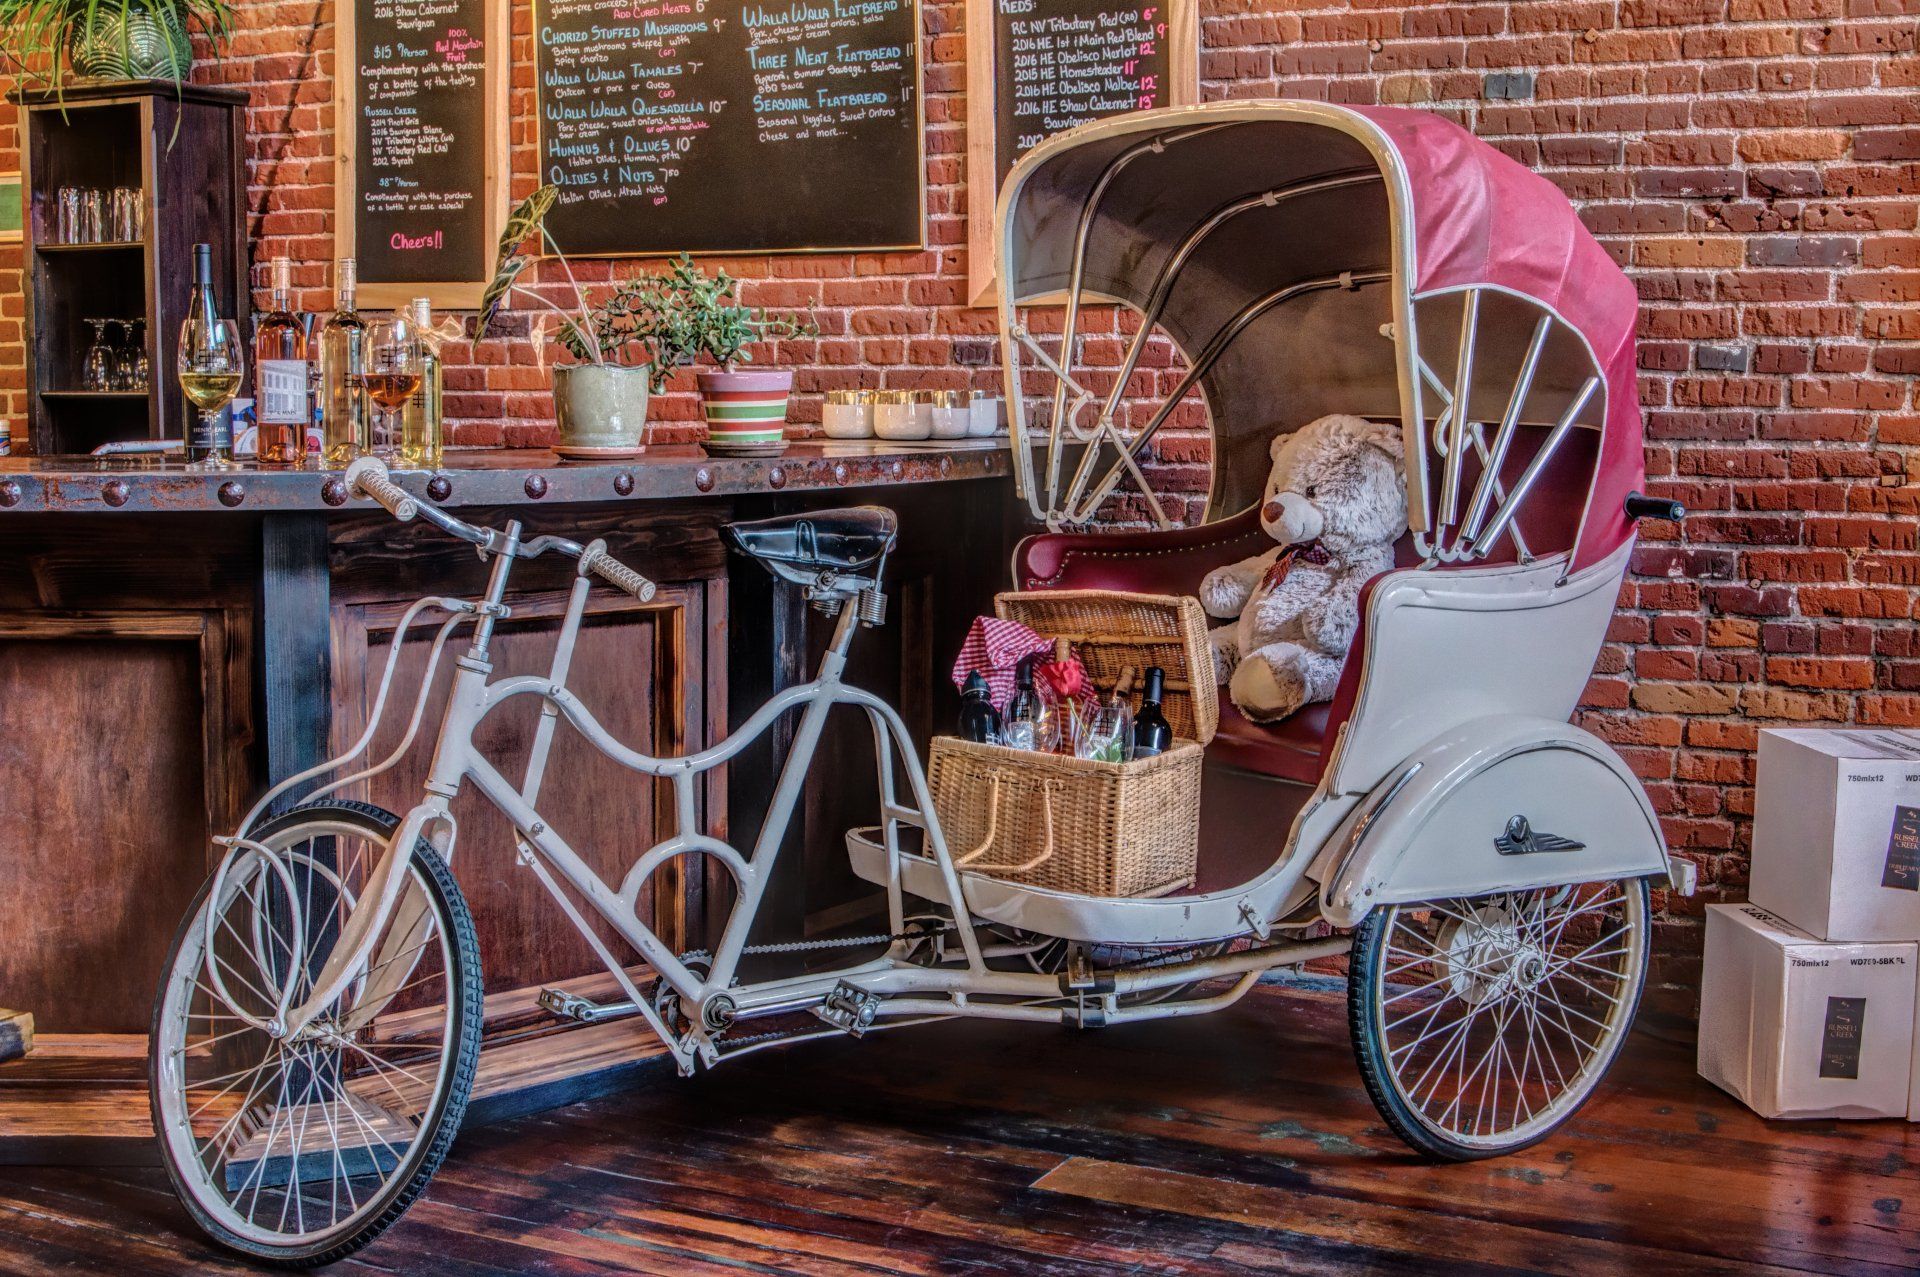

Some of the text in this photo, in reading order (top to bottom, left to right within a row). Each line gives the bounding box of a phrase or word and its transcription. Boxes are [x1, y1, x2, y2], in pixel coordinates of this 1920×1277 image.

[374, 2, 459, 18] 2016 Shaw Cabernet
[613, 9, 630, 20] ADD
[633, 7, 660, 19] CURED
[662, 4, 691, 15] MEATS
[743, 0, 898, 28] WALLA WALLA FLATBREAD
[396, 18, 435, 31] Sauvignon
[448, 29, 467, 37] 100%
[542, 20, 708, 46] CHORIZO STUFFED MUSHROOMS
[805, 20, 829, 31] sweet
[863, 16, 884, 24] salsa
[1012, 21, 1028, 35] RC
[1031, 20, 1047, 34] NV
[1048, 14, 1096, 34] Tributary
[1098, 11, 1118, 27] Red
[806, 30, 831, 39] cream
[1012, 38, 1036, 52] 2016
[1037, 36, 1054, 50] HE
[1080, 33, 1105, 46] Main
[1107, 30, 1124, 44] Red
[1125, 25, 1155, 42] Blend
[374, 45, 392, 59] $15
[552, 35, 691, 57] Button mushrooms stuffed with
[446, 52, 466, 62] Fruit
[555, 54, 609, 69] spicy chorizo
[745, 44, 901, 70] THREE MEAT FLATBREAD
[1014, 45, 1138, 68] 2016 HE Obelisco Merlot
[361, 62, 455, 80] Complimentary with the
[545, 63, 683, 86] WALLA WALLA TAMALES
[794, 69, 825, 81] Summer
[1014, 59, 1124, 82] 2015 HE Homesteader
[369, 82, 378, 92] of
[393, 79, 419, 89] bottle
[425, 80, 432, 90] of
[435, 76, 448, 86] the
[1015, 76, 1140, 98] 2016 HE Obelisco Malbec
[547, 97, 705, 120] WALLA WALLA QUESADILLA
[753, 88, 888, 113] SEASONAL FLATBREAD
[1014, 92, 1137, 116] 2016 HE Shaw Cabernet
[612, 117, 636, 128] sweet
[670, 115, 692, 124] salsa
[758, 115, 798, 129] Seasonal
[840, 111, 866, 122] Sweet
[869, 108, 896, 119] Onions
[759, 130, 789, 142] Cheese
[796, 129, 810, 139] and
[418, 143, 432, 154] Red
[549, 136, 670, 157] HUMMUS OLIVES
[392, 156, 414, 167] Syrah
[569, 157, 593, 168] Italian
[662, 152, 681, 162] pita
[550, 165, 655, 185] OLIVES NUTS
[559, 193, 585, 205] Italian
[619, 184, 643, 198] Mixed
[391, 230, 443, 250] Cheers!!
